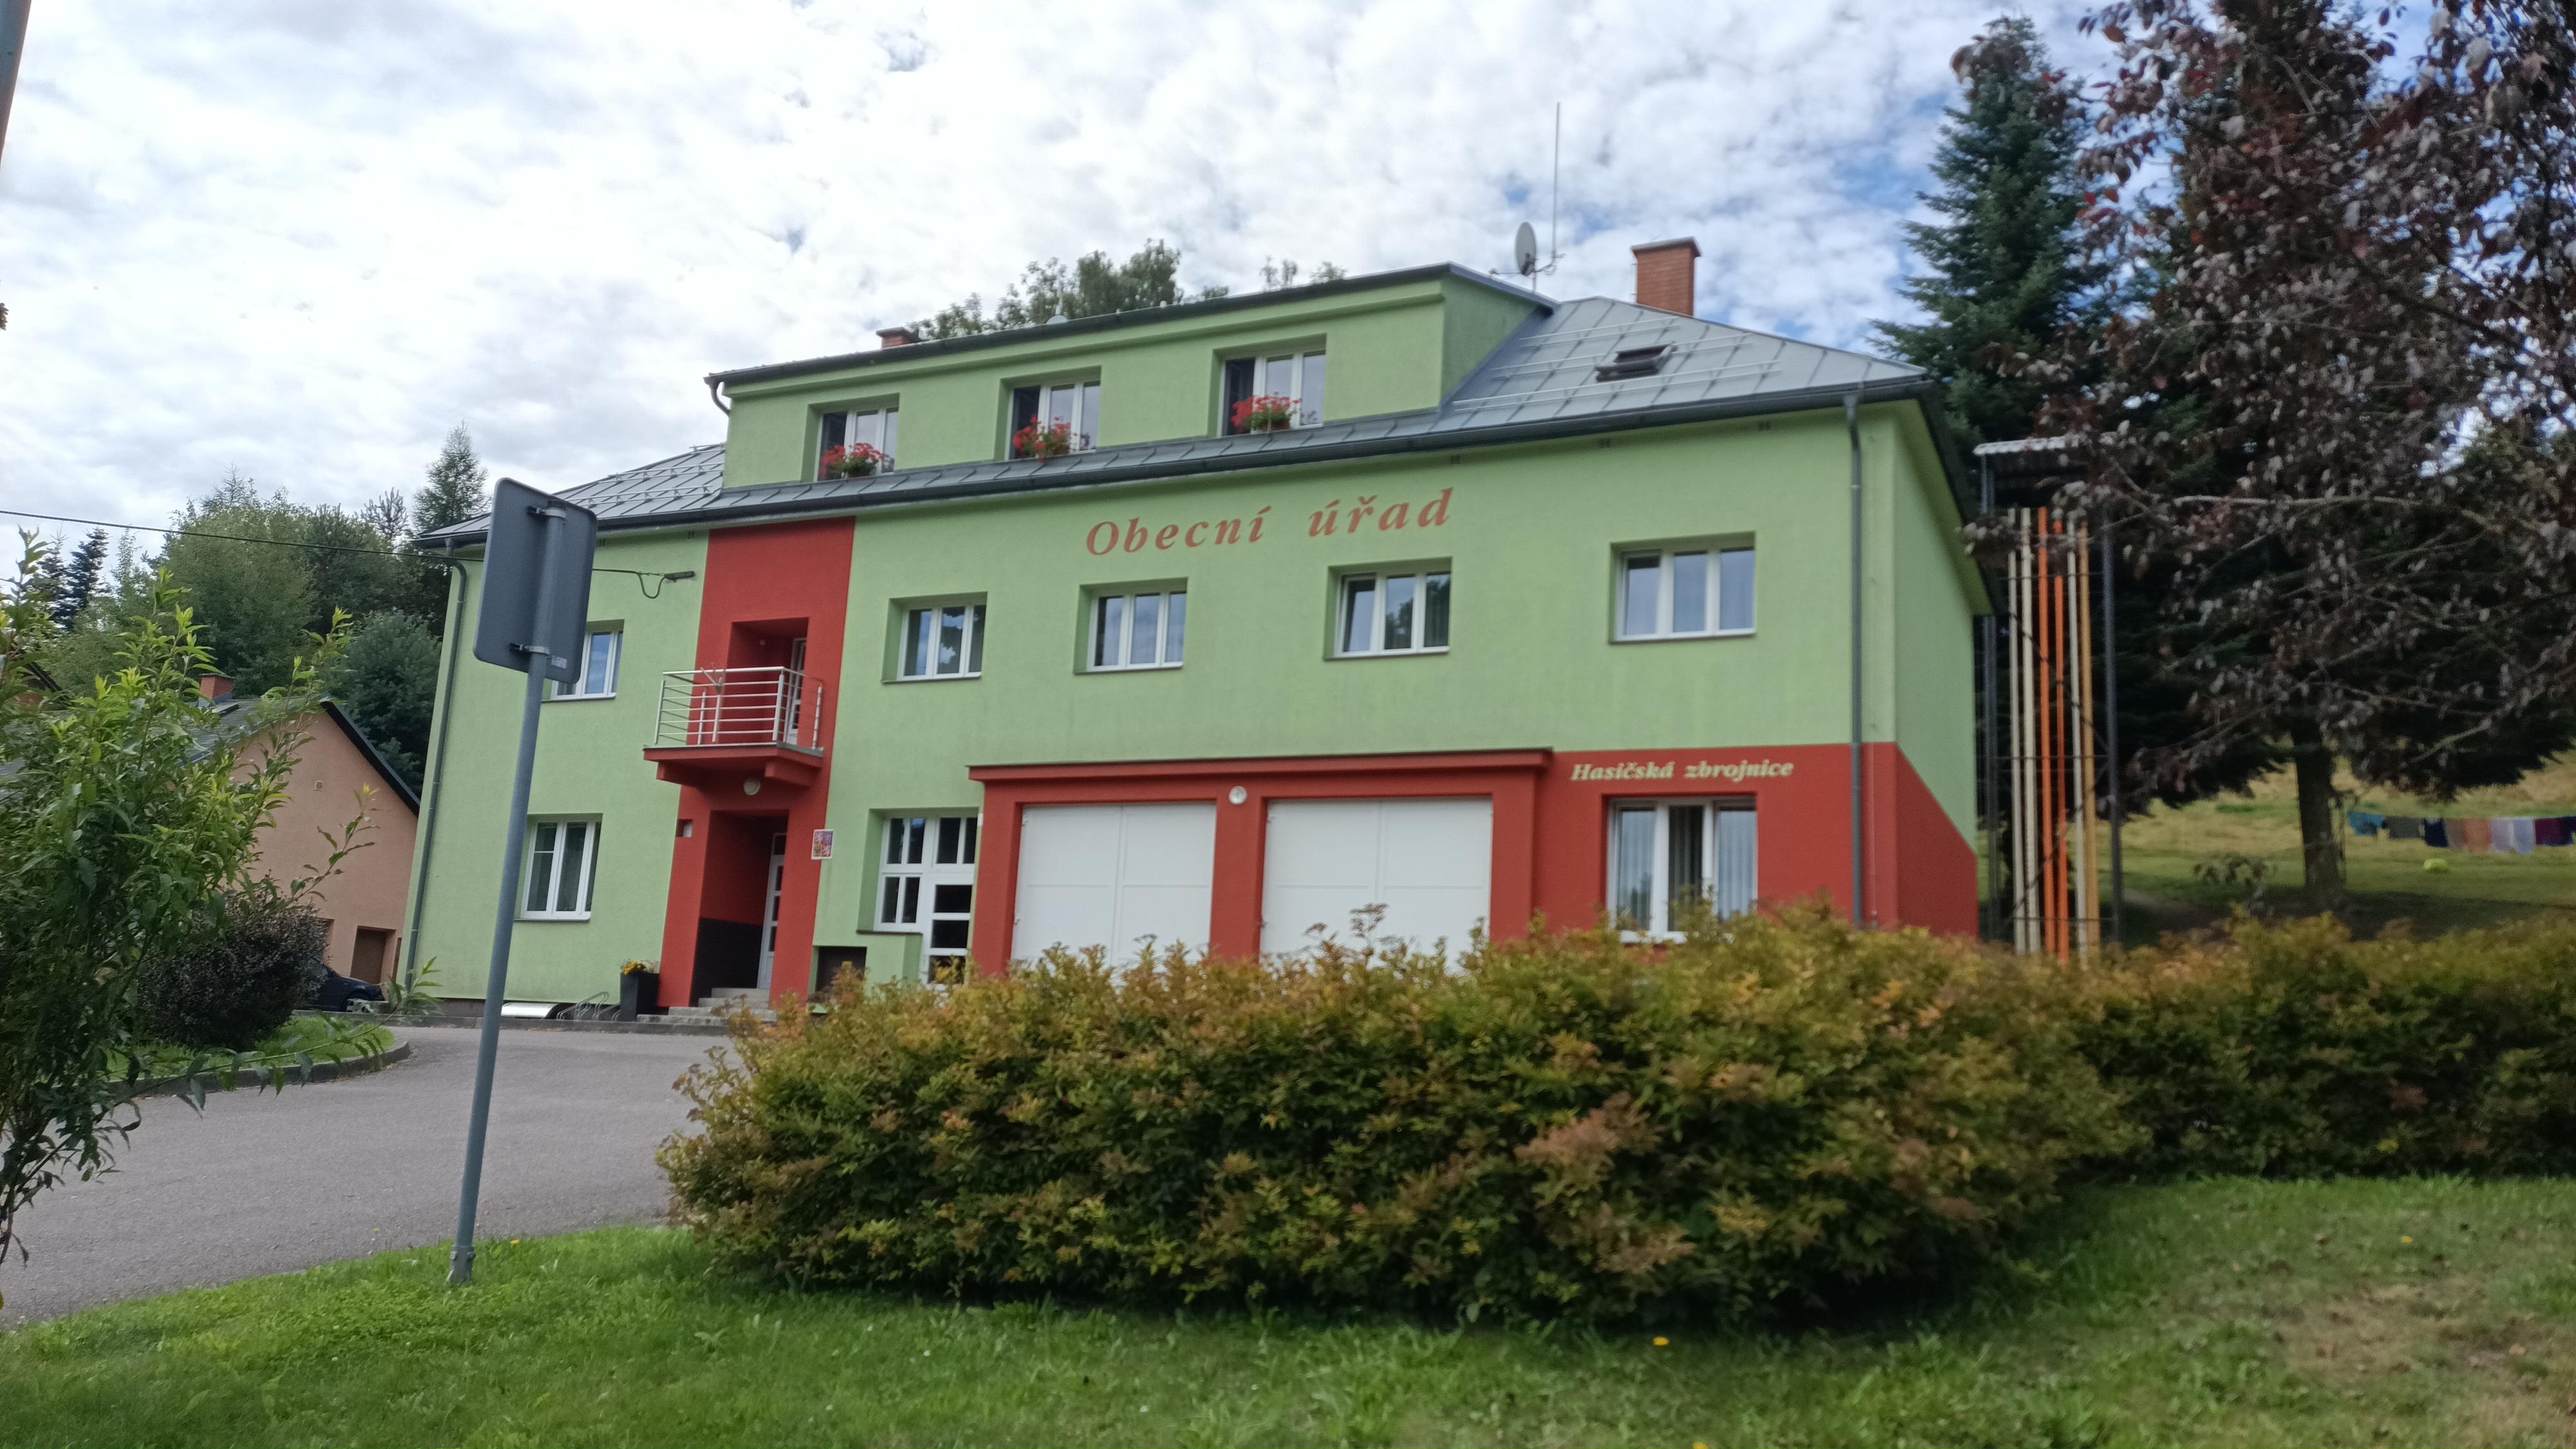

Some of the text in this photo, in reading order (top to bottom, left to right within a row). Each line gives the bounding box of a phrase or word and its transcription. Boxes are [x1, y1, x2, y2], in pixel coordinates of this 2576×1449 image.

[1086, 488, 1453, 556] Obecní úřad
[1571, 759, 1794, 782] Hasičská zbrojnice
